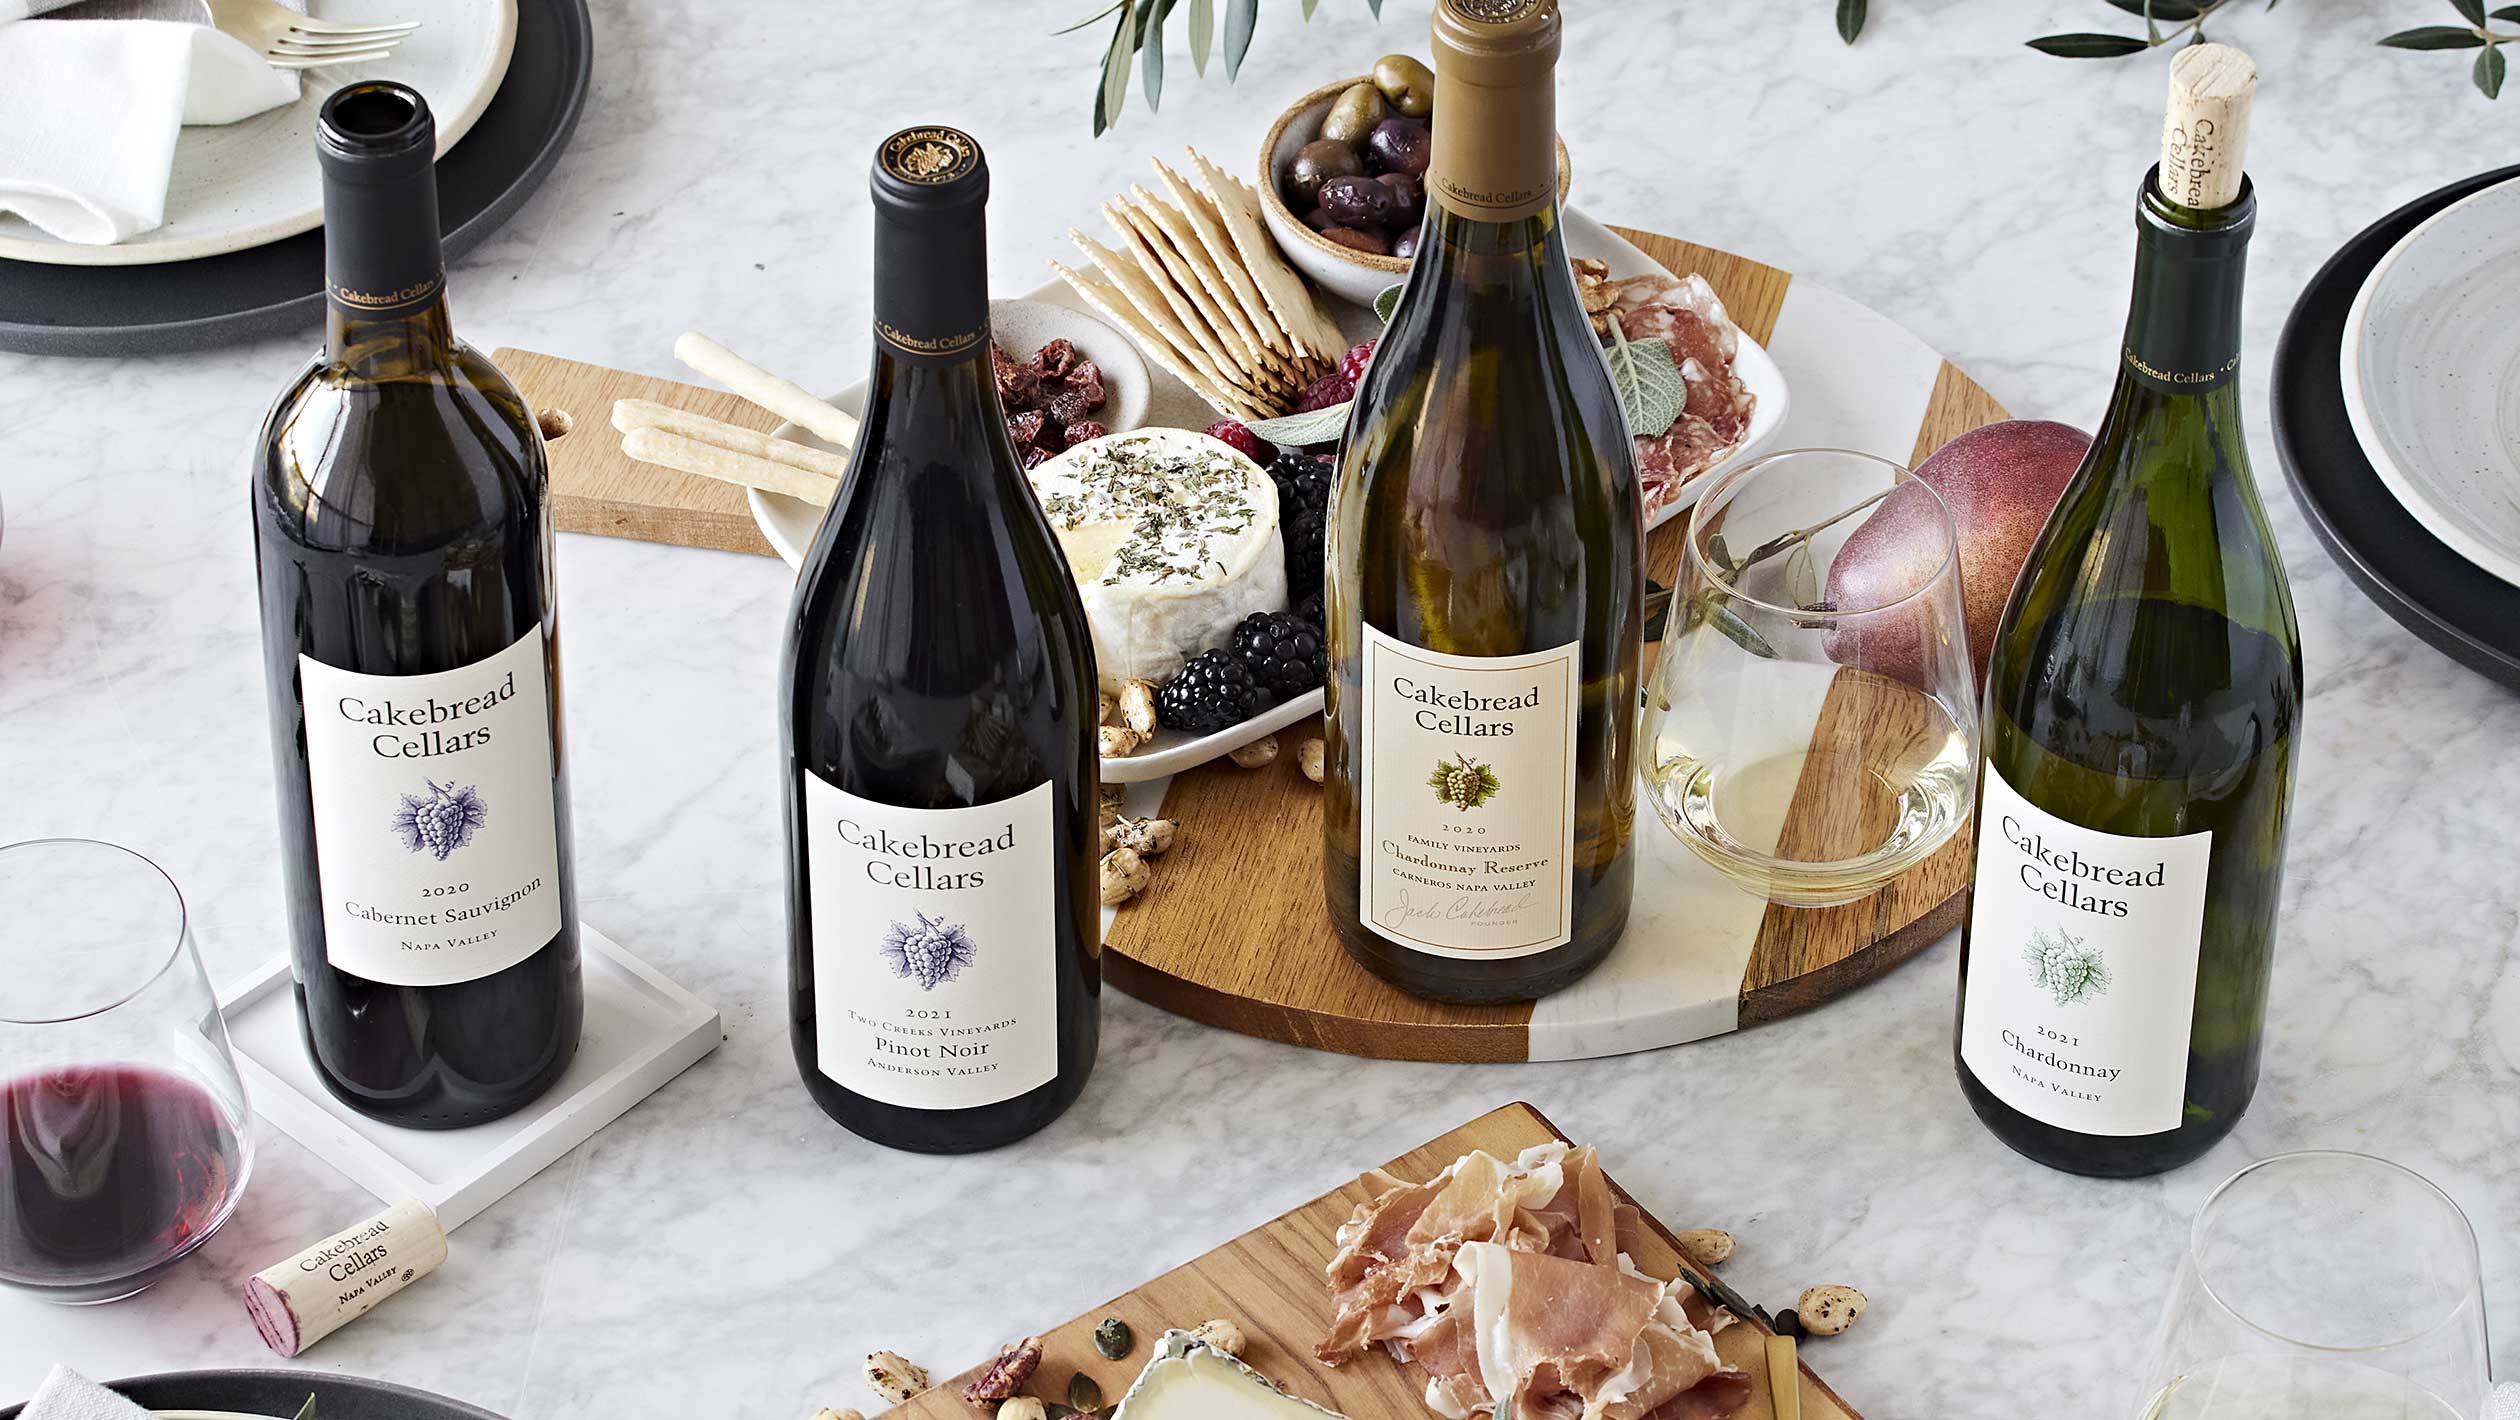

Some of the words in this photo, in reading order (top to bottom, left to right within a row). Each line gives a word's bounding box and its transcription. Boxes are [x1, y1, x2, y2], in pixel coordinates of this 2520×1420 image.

[2167, 127, 2188, 195] Cellars
[2188, 118, 2215, 207] Cakebrea
[1441, 177, 1493, 203] Cakebread
[1495, 190, 1532, 203] Cellars
[340, 287, 398, 305] Cakebread
[883, 324, 937, 349] Cakebread
[939, 332, 976, 349] Cellars
[2125, 347, 2171, 382] Cakebread
[2173, 372, 2215, 384] Cellars
[339, 671, 516, 726] Cakebread
[1393, 677, 1540, 712] Cakebread
[1415, 710, 1514, 737] Cellars
[372, 726, 491, 759] Cellars
[837, 819, 1016, 860] Cakebread
[1407, 834, 1449, 850] FAMILY
[1454, 844, 1521, 853] VINEYARDS
[1442, 824, 1487, 835] 2020
[1382, 839, 1477, 876] Chardonnay
[1483, 857, 1549, 874] Reserve
[2002, 815, 2165, 888] Cakebread
[422, 882, 470, 898] 2020
[866, 860, 985, 891] Cellars
[1392, 867, 1452, 890] CARNEROS
[1456, 883, 1489, 892] NAPA
[1493, 879, 1536, 891] VALLEY
[2020, 864, 2128, 918] Cellars
[345, 901, 438, 926] Cabernet
[445, 876, 541, 924] Sauvignon
[1384, 888, 1441, 929] Jack
[905, 1008, 951, 1020] 2021
[875, 1036, 932, 1059] Pinot
[939, 1041, 990, 1059] Noir
[2037, 1025, 2080, 1047] 2021
[2002, 1029, 2121, 1082] Chardonnay
[299, 1220, 390, 1272] Cakebread
[328, 1244, 388, 1282] Cellars
